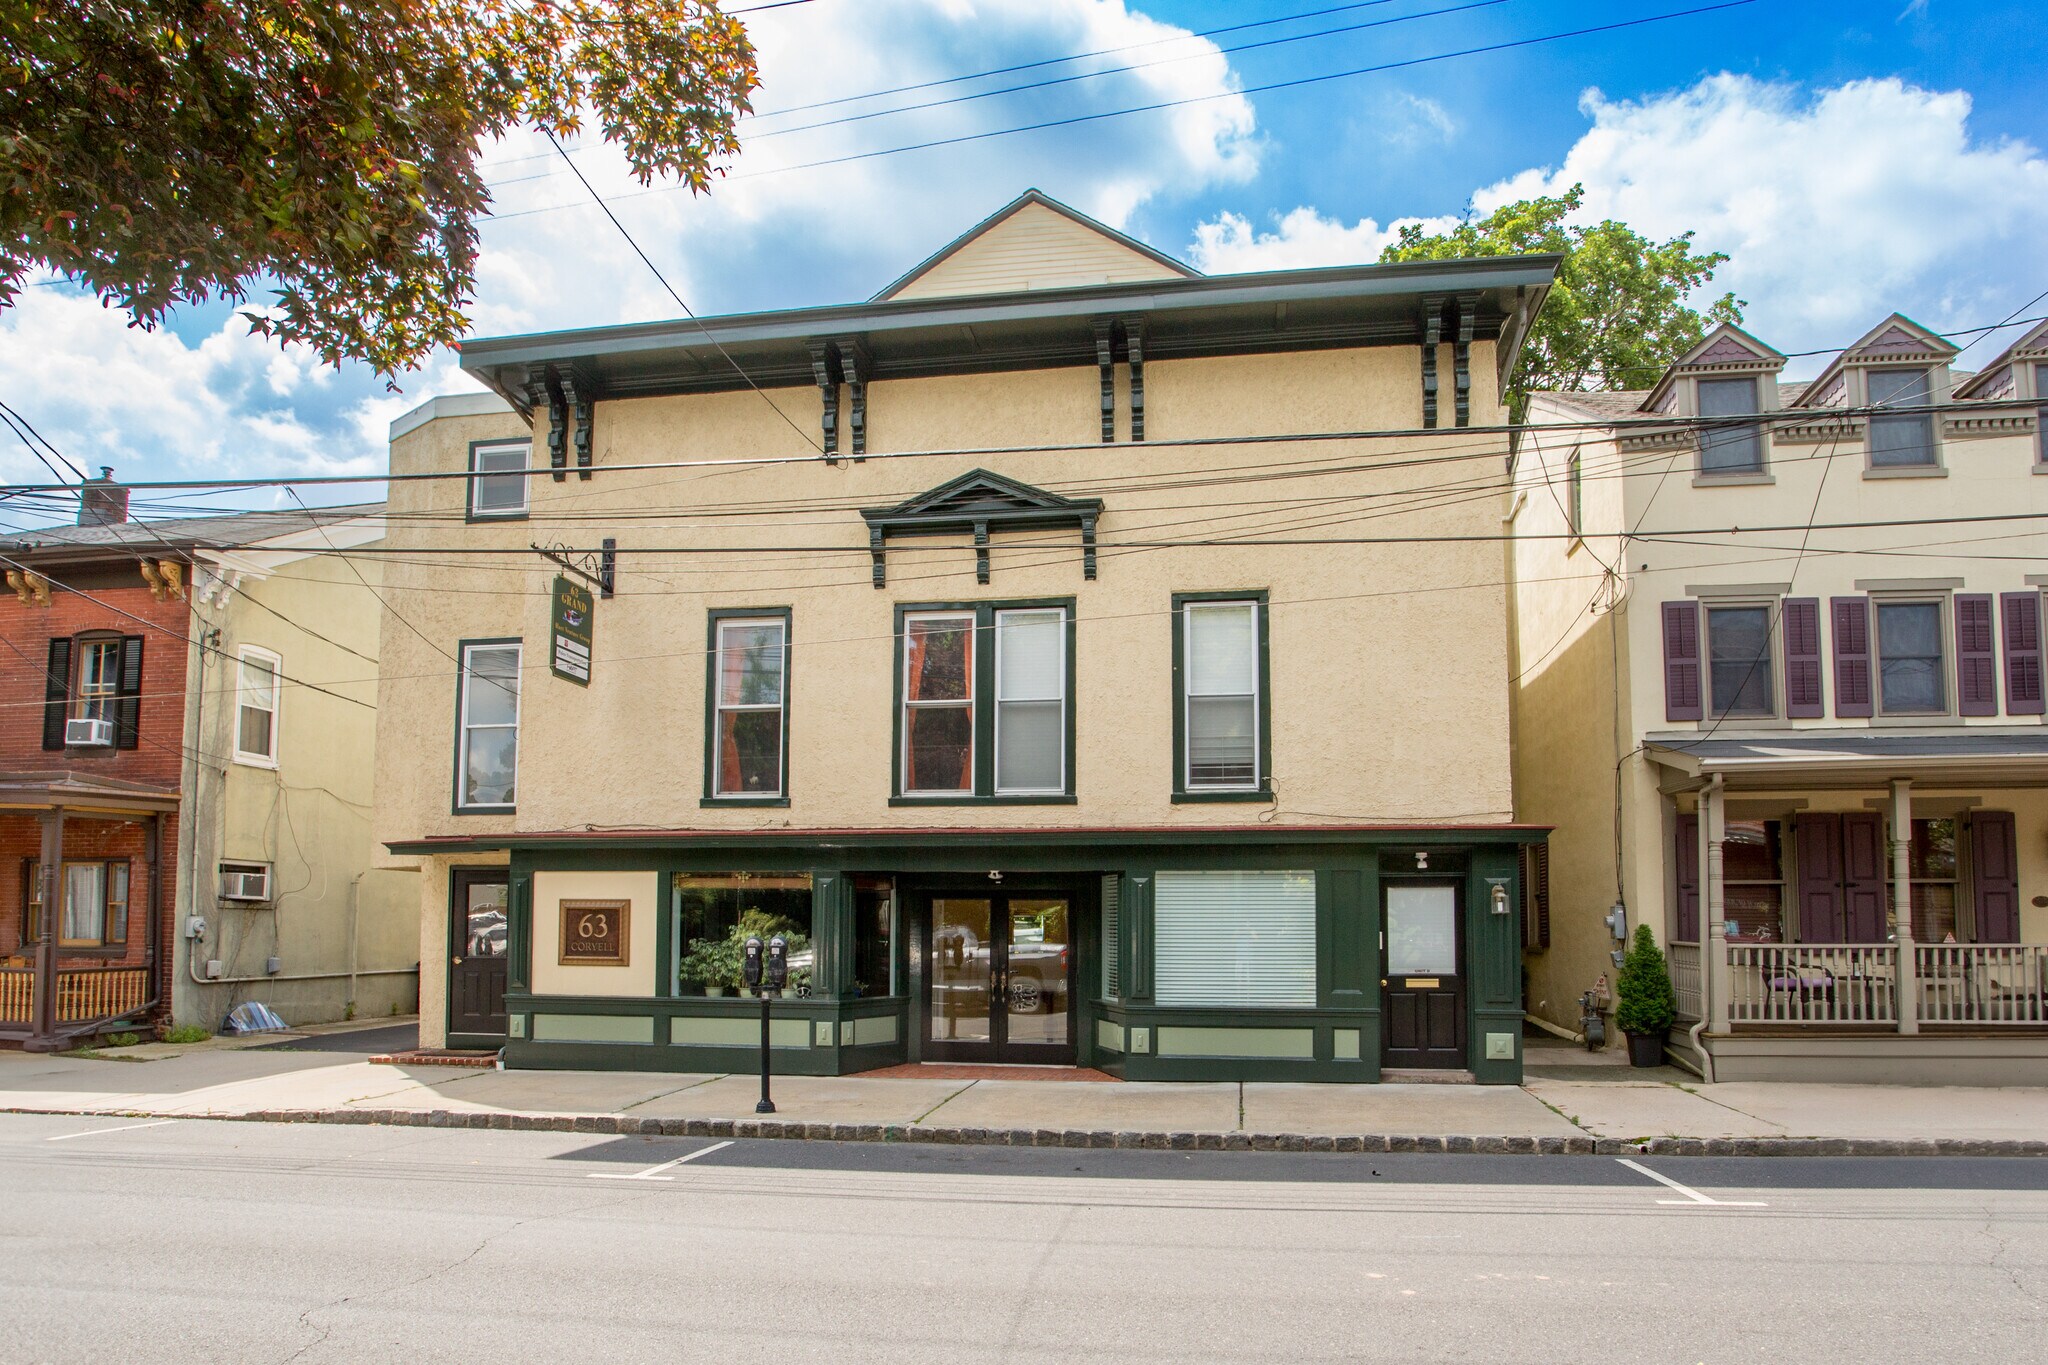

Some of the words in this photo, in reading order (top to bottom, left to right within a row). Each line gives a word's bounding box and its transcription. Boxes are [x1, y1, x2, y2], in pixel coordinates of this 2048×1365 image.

[570, 586, 579, 598] 63
[561, 593, 587, 614] GRAND
[578, 913, 608, 938] 63
[570, 942, 615, 951] CORYELL
